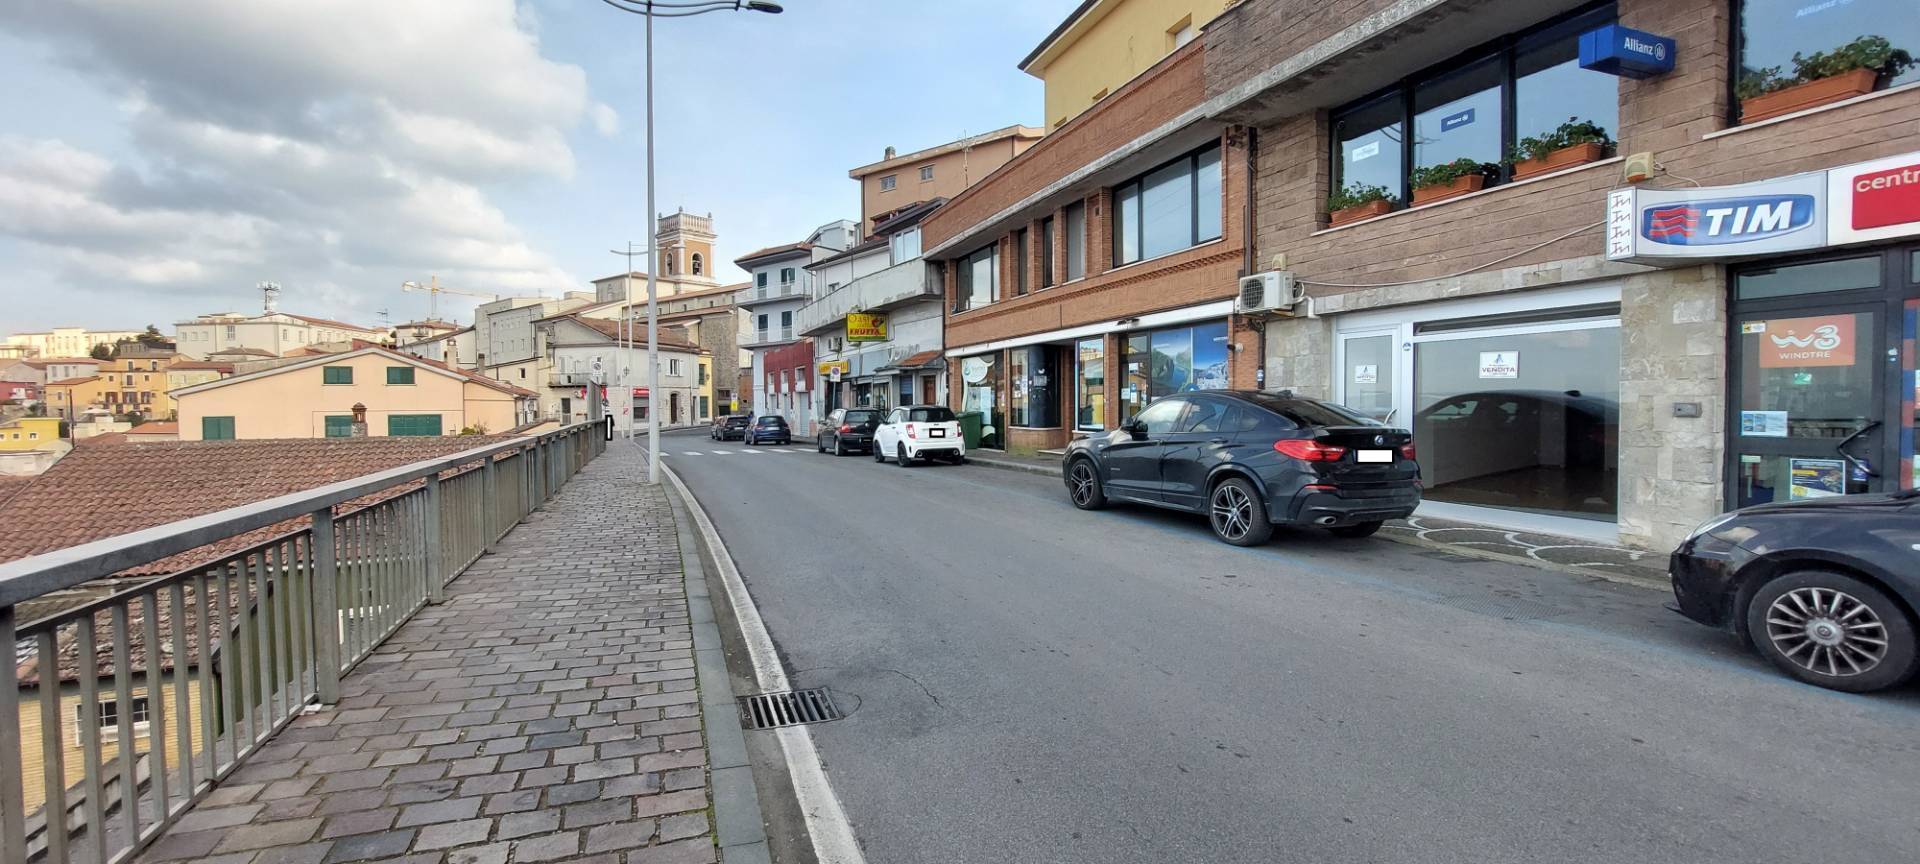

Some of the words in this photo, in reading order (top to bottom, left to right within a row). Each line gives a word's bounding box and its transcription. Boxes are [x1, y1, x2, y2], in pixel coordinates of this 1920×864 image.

[1624, 37, 1653, 55] Allianz
[1705, 201, 1793, 236] TIM
[849, 328, 881, 336] FRUTTA
[1779, 351, 1831, 360] WINDTRE
